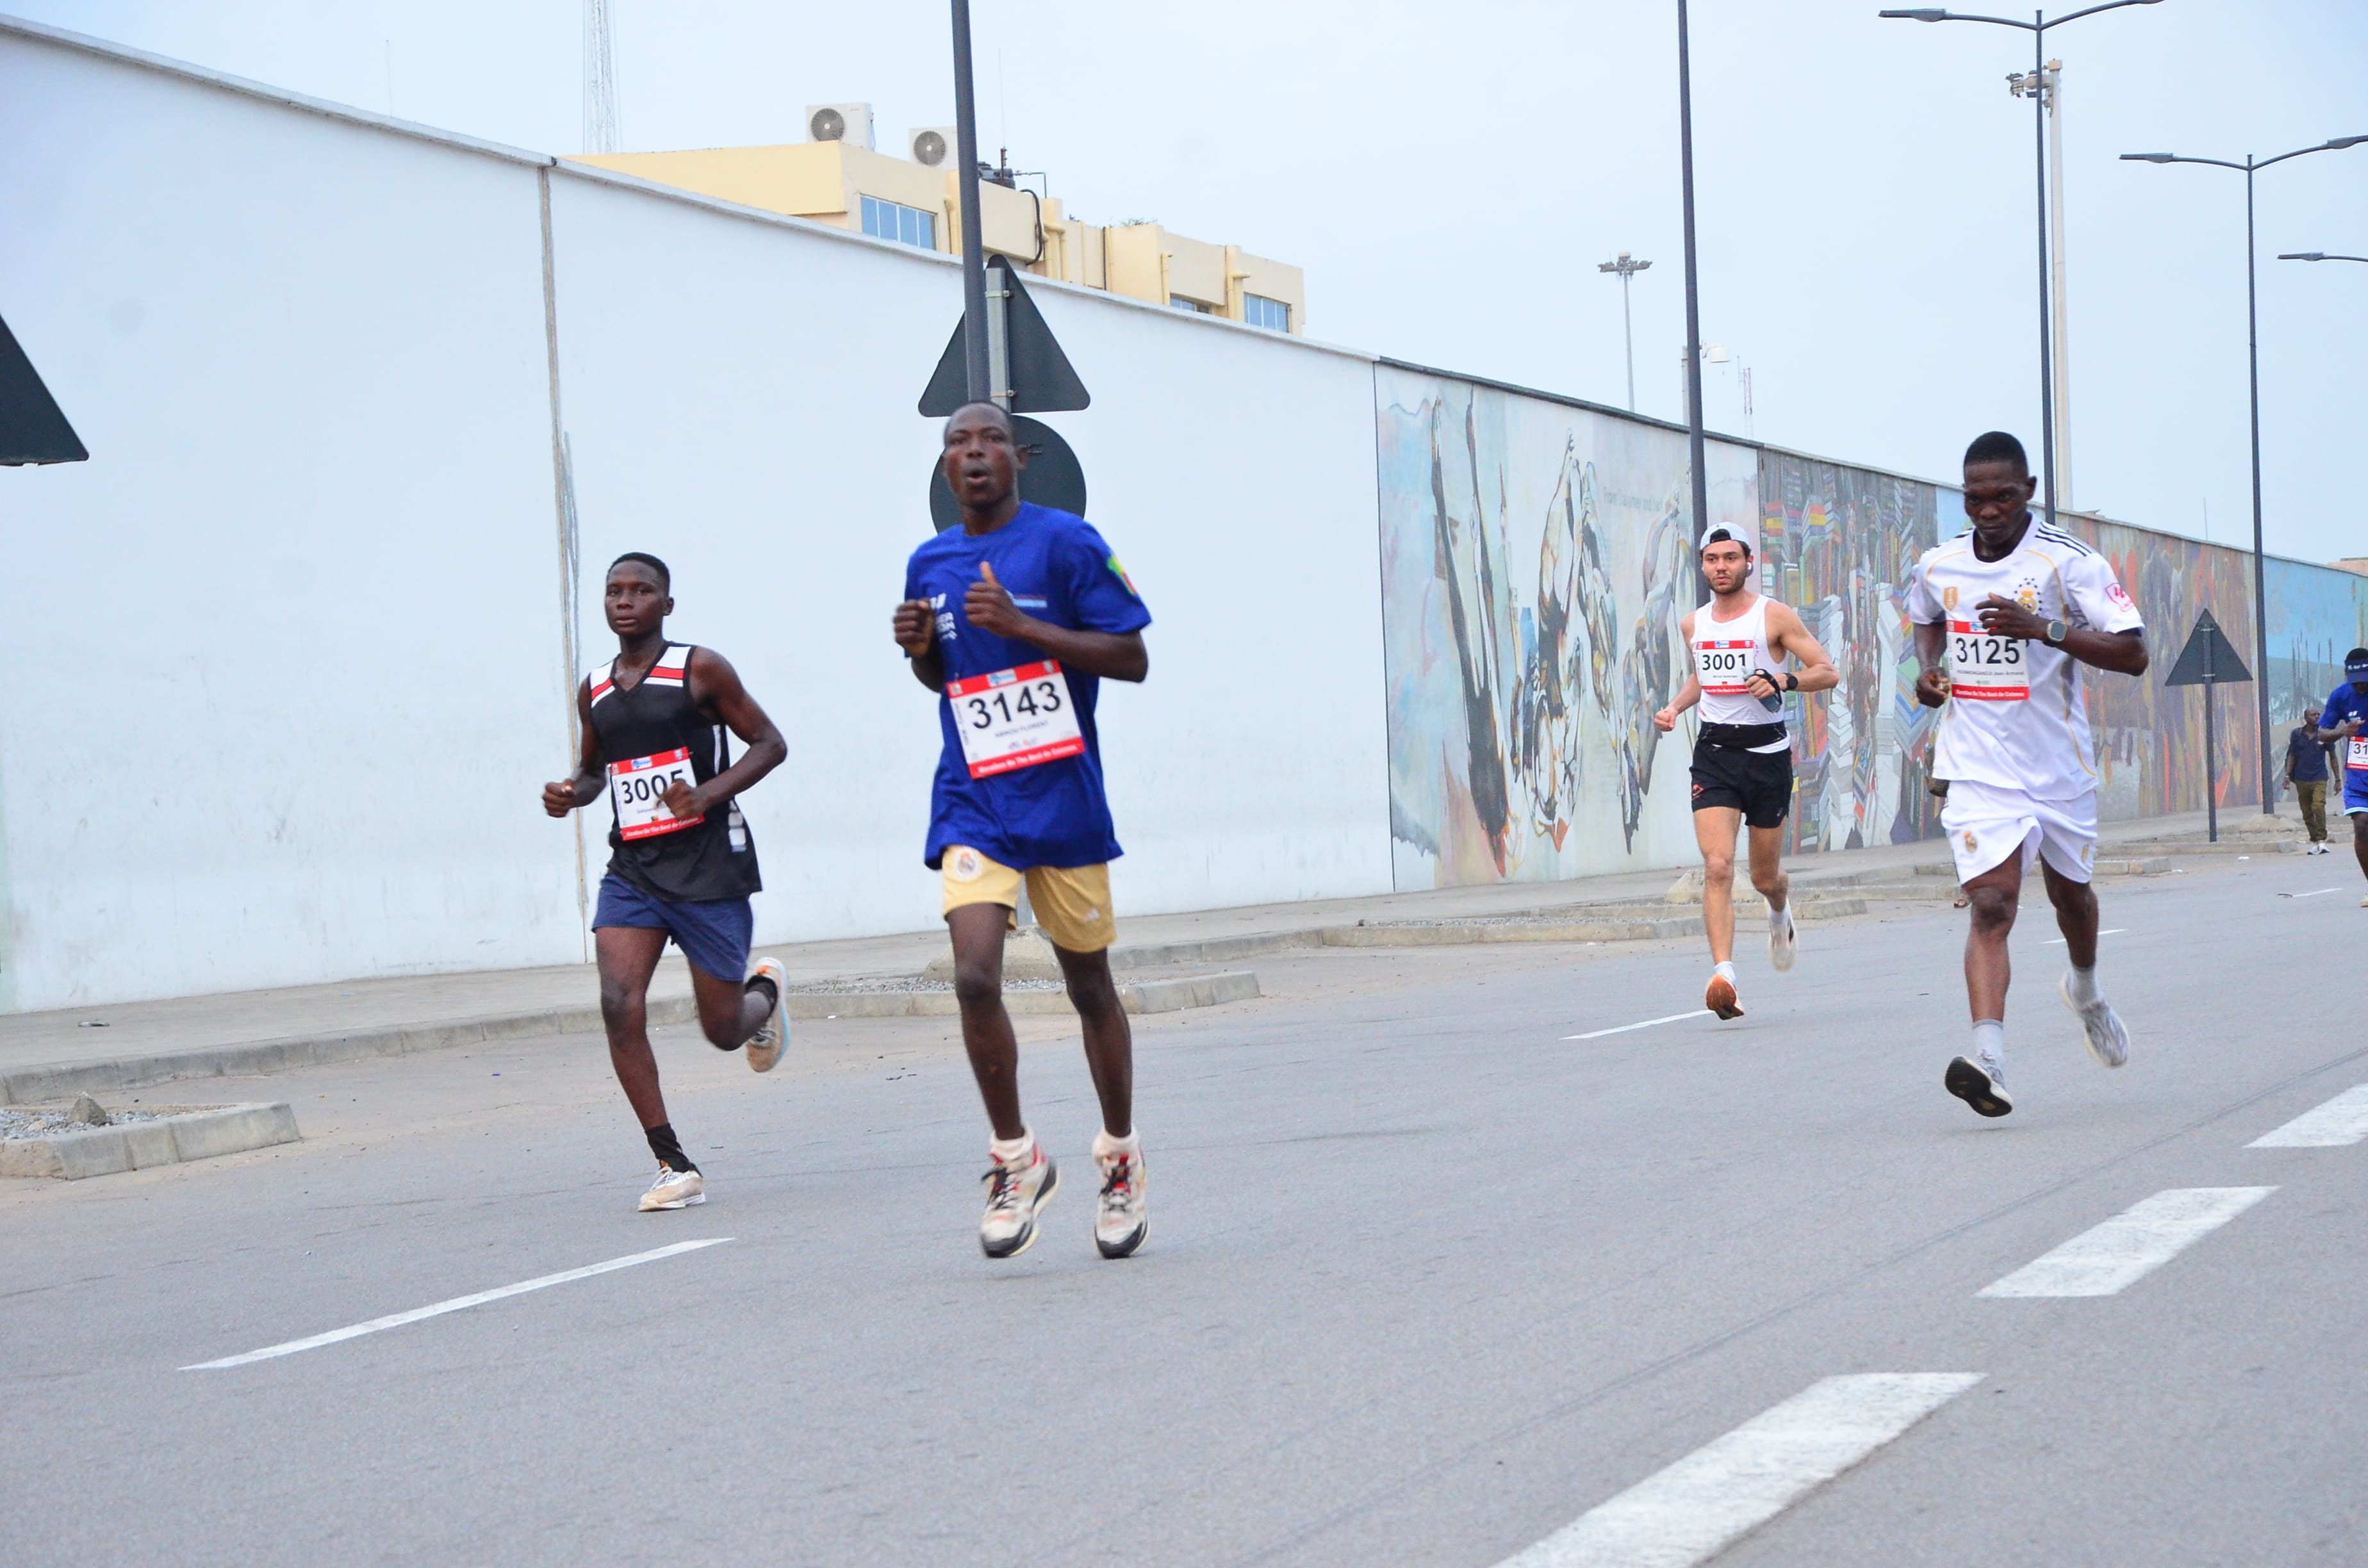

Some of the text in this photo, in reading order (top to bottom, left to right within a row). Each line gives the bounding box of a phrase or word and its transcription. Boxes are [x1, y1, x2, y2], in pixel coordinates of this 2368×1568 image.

[1702, 653, 1747, 671] 3001
[1955, 637, 2020, 664] 3125
[968, 681, 1061, 730] 3143
